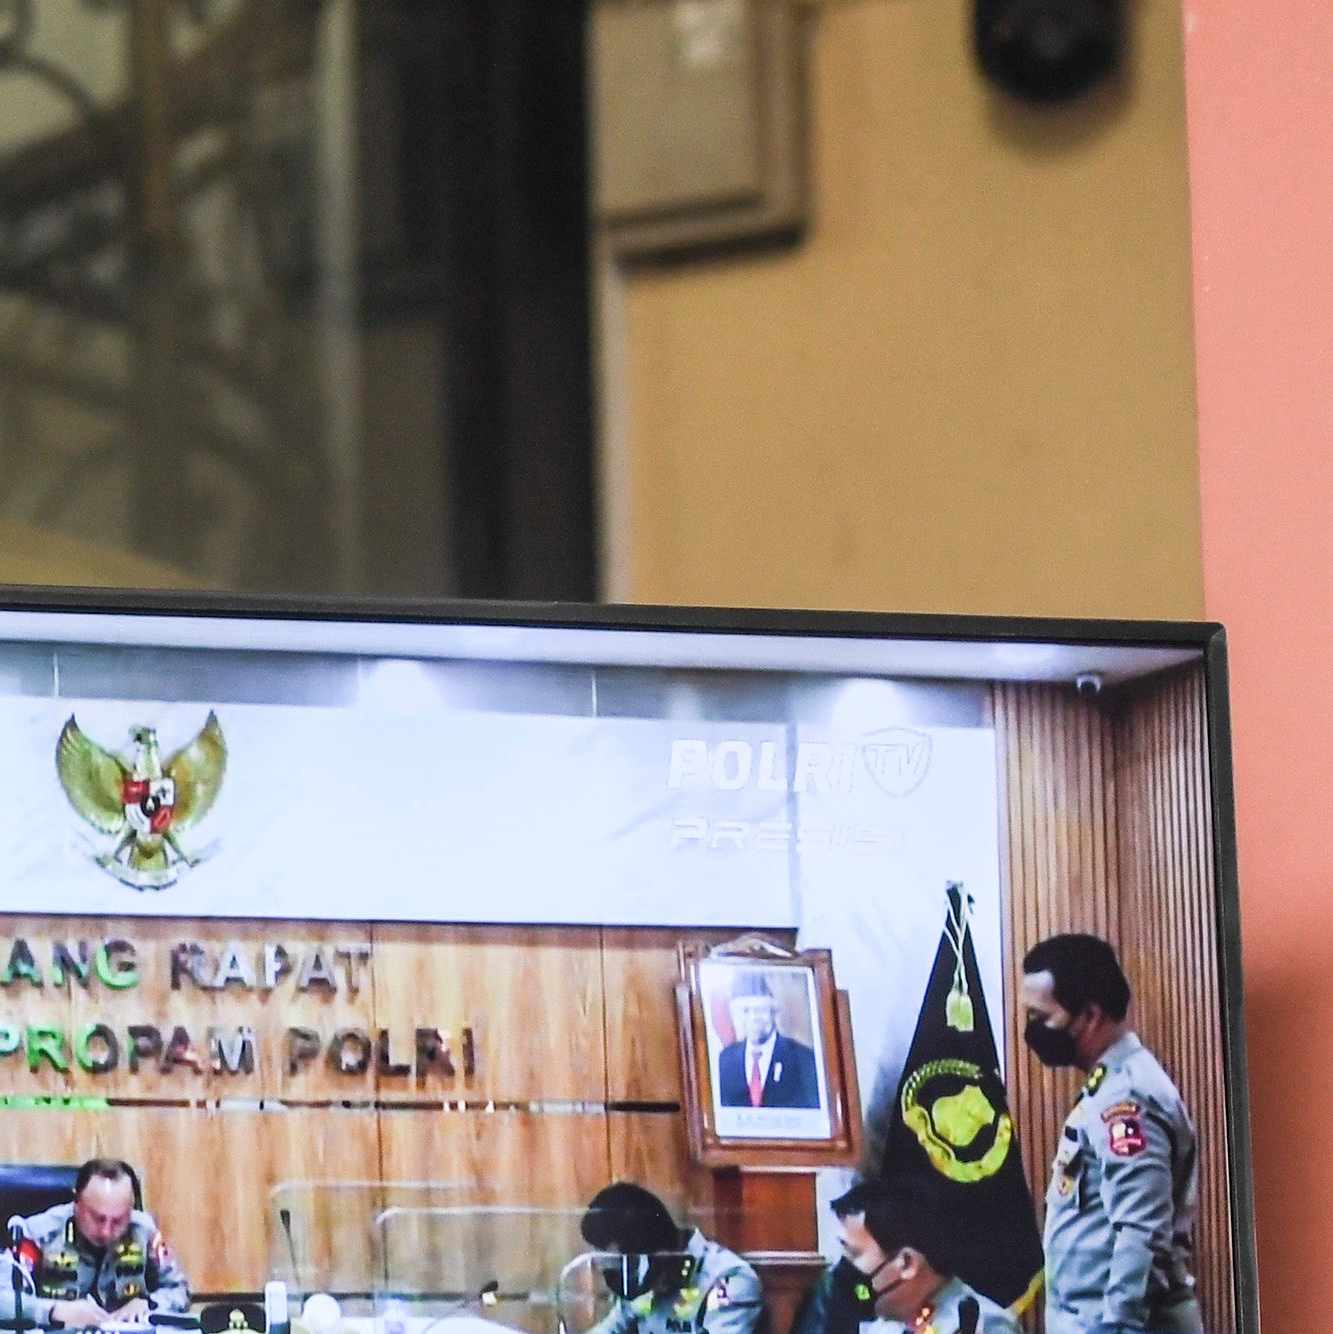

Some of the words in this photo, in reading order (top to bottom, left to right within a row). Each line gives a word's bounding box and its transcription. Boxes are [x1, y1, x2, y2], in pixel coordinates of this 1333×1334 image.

[666, 738, 859, 793] POLRI
[866, 741, 929, 777] TV
[169, 941, 370, 994] RAPAT
[288, 1024, 476, 1078] POLRI
